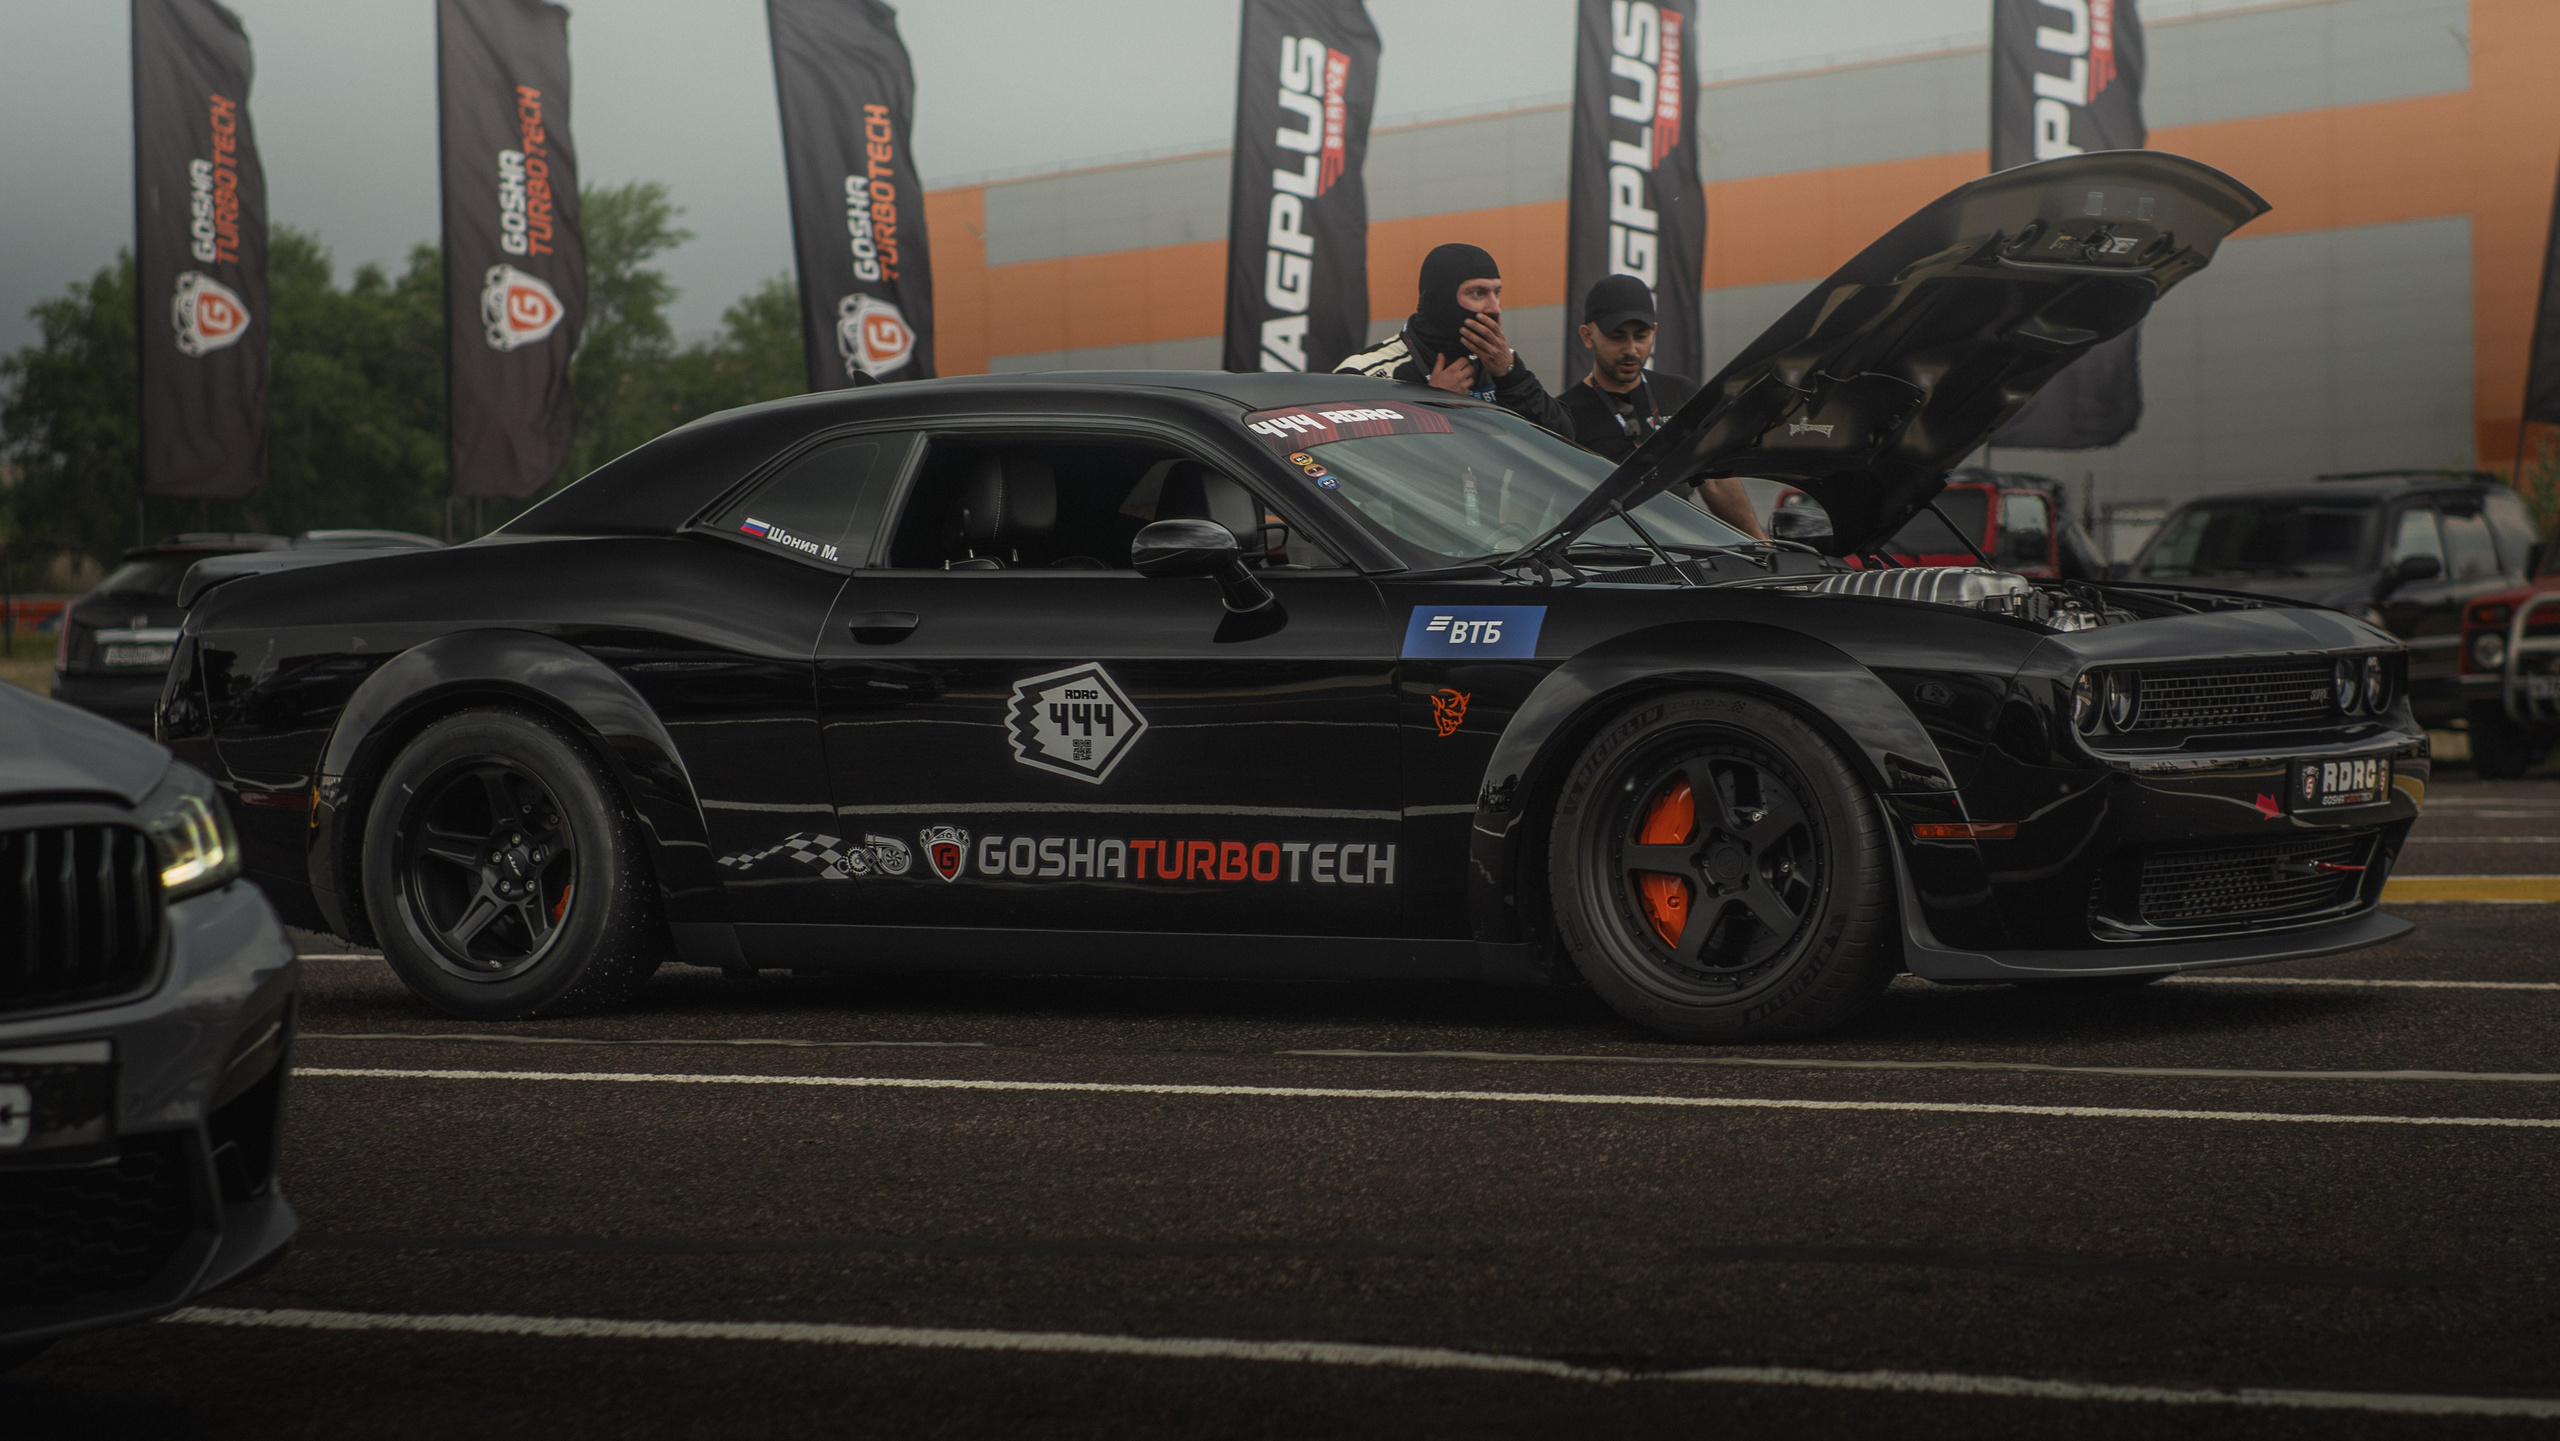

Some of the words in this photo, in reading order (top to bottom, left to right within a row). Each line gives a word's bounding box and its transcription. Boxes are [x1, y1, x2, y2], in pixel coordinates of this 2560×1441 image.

[209, 93, 240, 265] TURBOTECH
[516, 84, 554, 257] TURBOTECH
[863, 103, 900, 283] TURBOTECH
[1609, 0, 1661, 320] GPLUS
[189, 158, 217, 264] GOSHA
[498, 149, 529, 256] GOSHA
[845, 174, 881, 283] GOSHA
[1248, 413, 1327, 438] 444
[766, 526, 819, 555] Шония
[820, 543, 839, 562] М.
[1449, 620, 1503, 644] ВТБ
[1049, 703, 1114, 736] 444
[1064, 689, 1099, 700] RDRC
[2322, 759, 2377, 792] RDRC
[978, 836, 1396, 885] GOSHATURBOTECH
